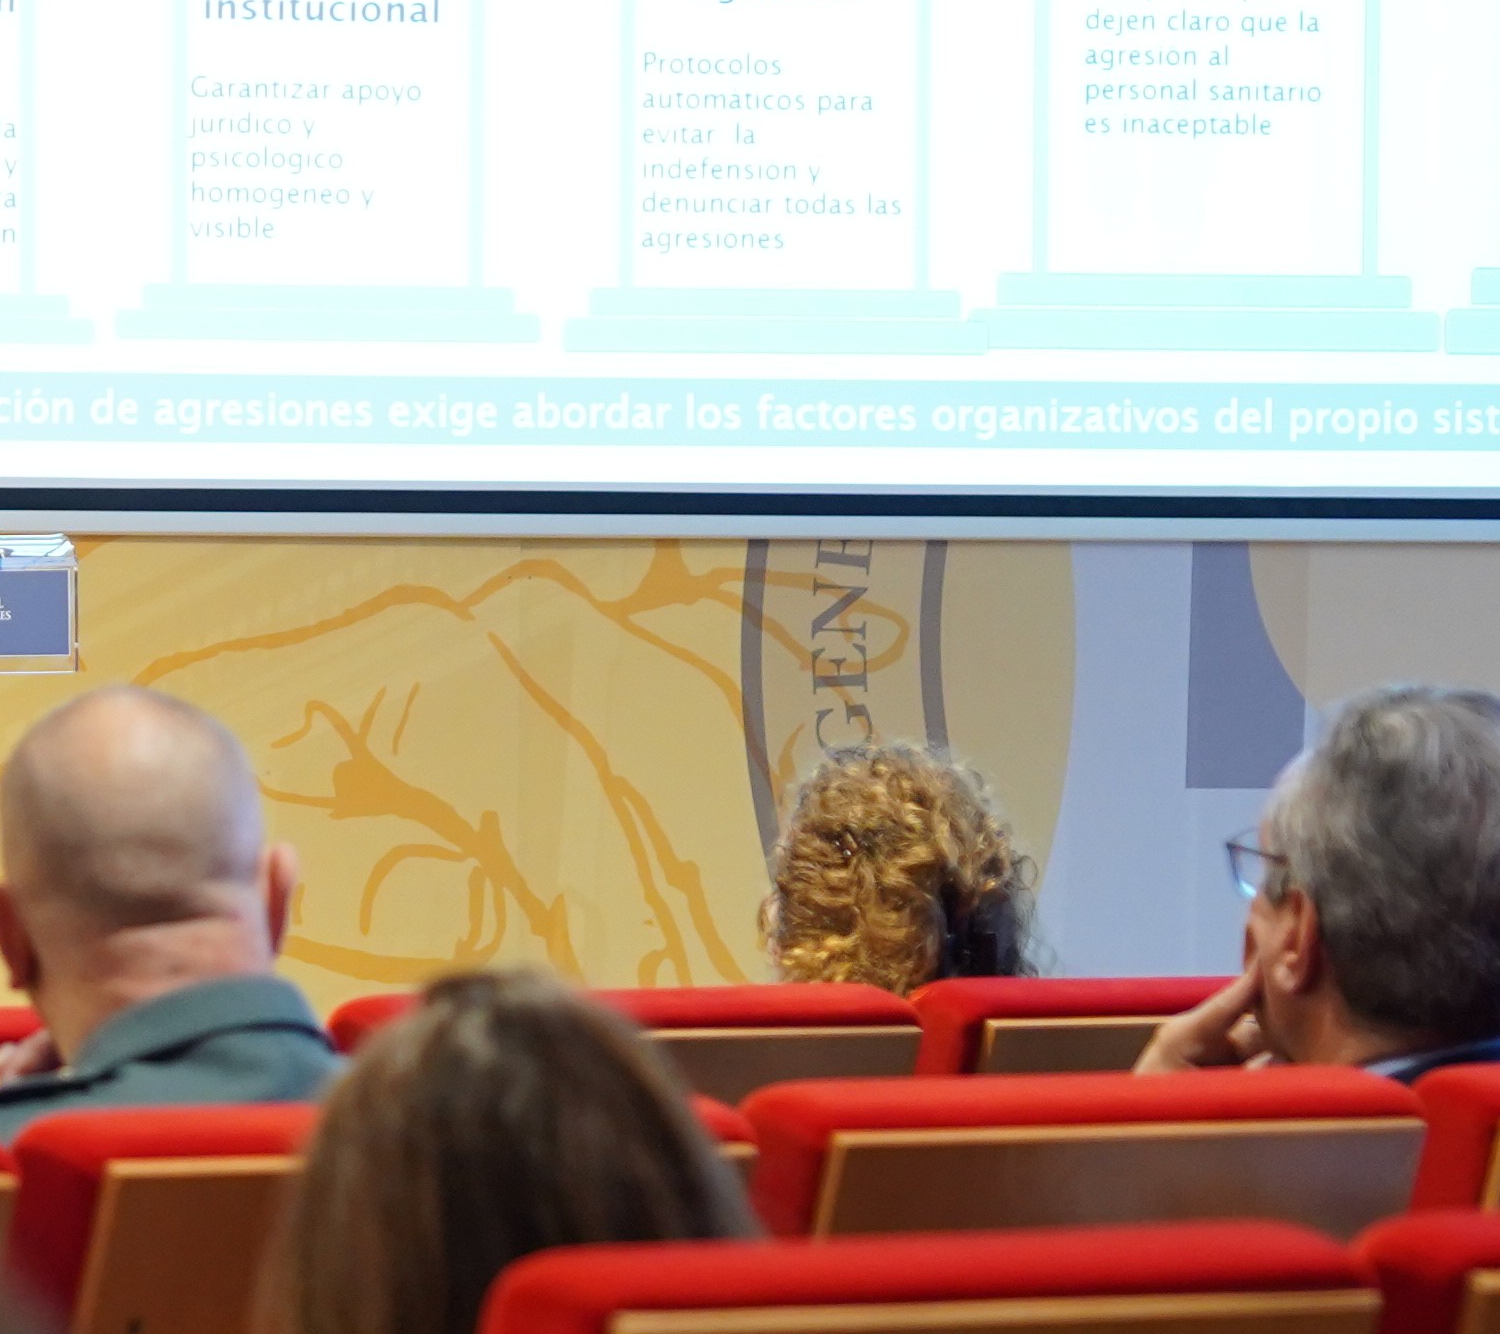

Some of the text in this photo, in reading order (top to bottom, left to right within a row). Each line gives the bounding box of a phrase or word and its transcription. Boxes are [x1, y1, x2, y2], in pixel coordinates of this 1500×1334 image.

[1084, 8, 1321, 38] dejen claro que la
[642, 51, 783, 76] Protocolos
[1207, 44, 1230, 67] al
[190, 75, 423, 107] Garantizar apoyo
[1084, 78, 1323, 105] personal sanitario
[817, 94, 874, 116] para
[302, 118, 317, 140] y
[641, 123, 757, 146] evitar la
[1084, 112, 1273, 140] es inaceptable
[4, 157, 18, 179] y
[808, 165, 822, 185] y
[360, 188, 375, 210] y
[641, 190, 903, 217] denunciar todas las
[189, 215, 275, 240] visible
[641, 228, 785, 255] agresiones
[89, 388, 139, 425] de
[154, 389, 374, 441] agresiones
[387, 392, 499, 438] exige
[510, 392, 672, 431] abordar
[685, 392, 743, 431] los
[757, 393, 917, 432] factores
[931, 396, 1201, 440] organizativos
[1213, 397, 1274, 435] del
[1289, 399, 1418, 443] propio
